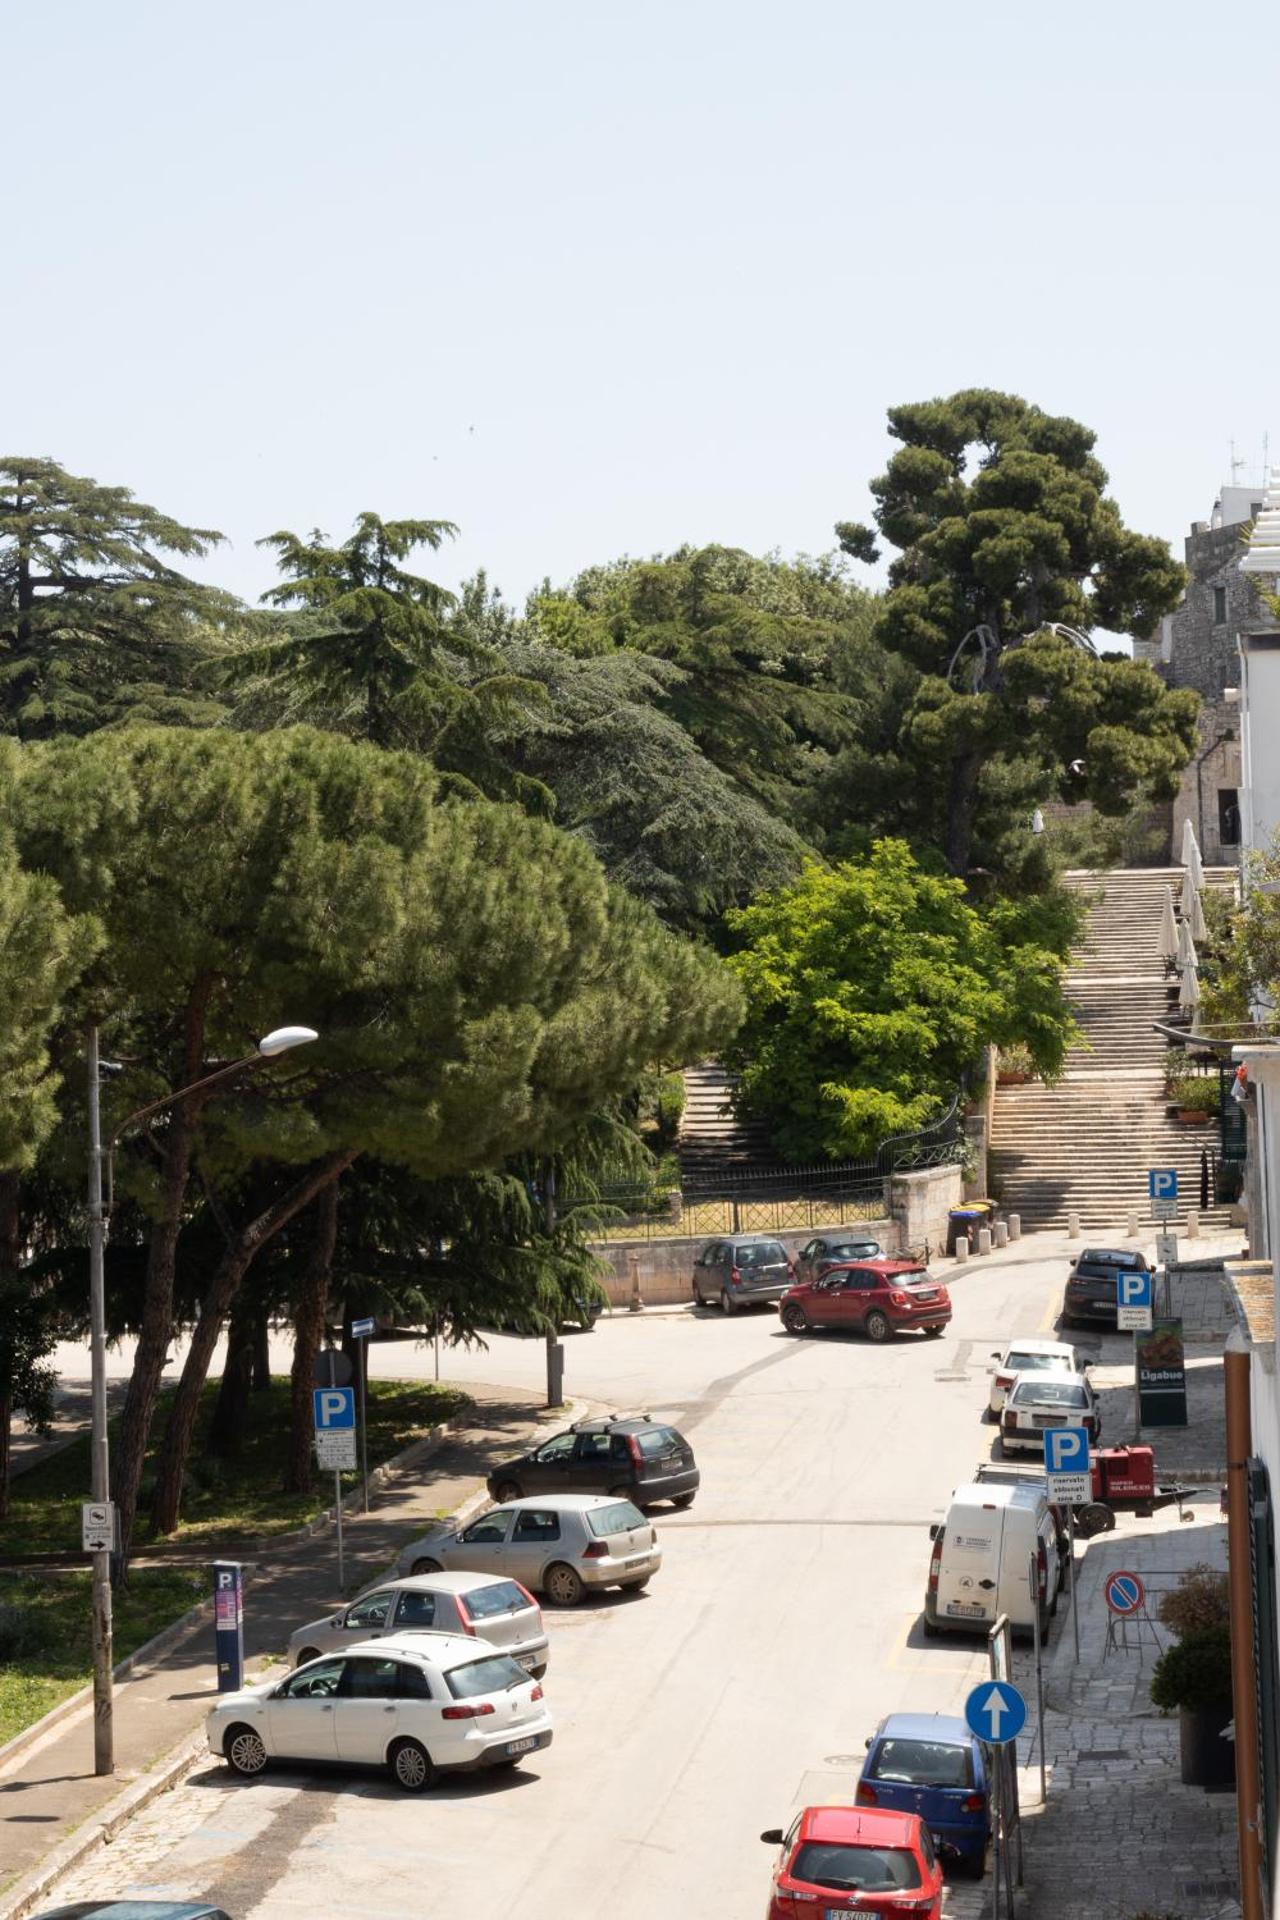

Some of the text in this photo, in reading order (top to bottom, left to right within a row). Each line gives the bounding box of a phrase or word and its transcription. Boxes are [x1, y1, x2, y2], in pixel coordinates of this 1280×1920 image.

[1154, 1173, 1173, 1196] P
[1123, 1275, 1145, 1304] P
[1141, 1371, 1183, 1381] Ligabue
[321, 1392, 346, 1426] P
[1052, 1432, 1080, 1469] P
[1053, 1476, 1085, 1484] riservato
[1053, 1485, 1085, 1493] abbonati
[219, 1574, 232, 1589] P
